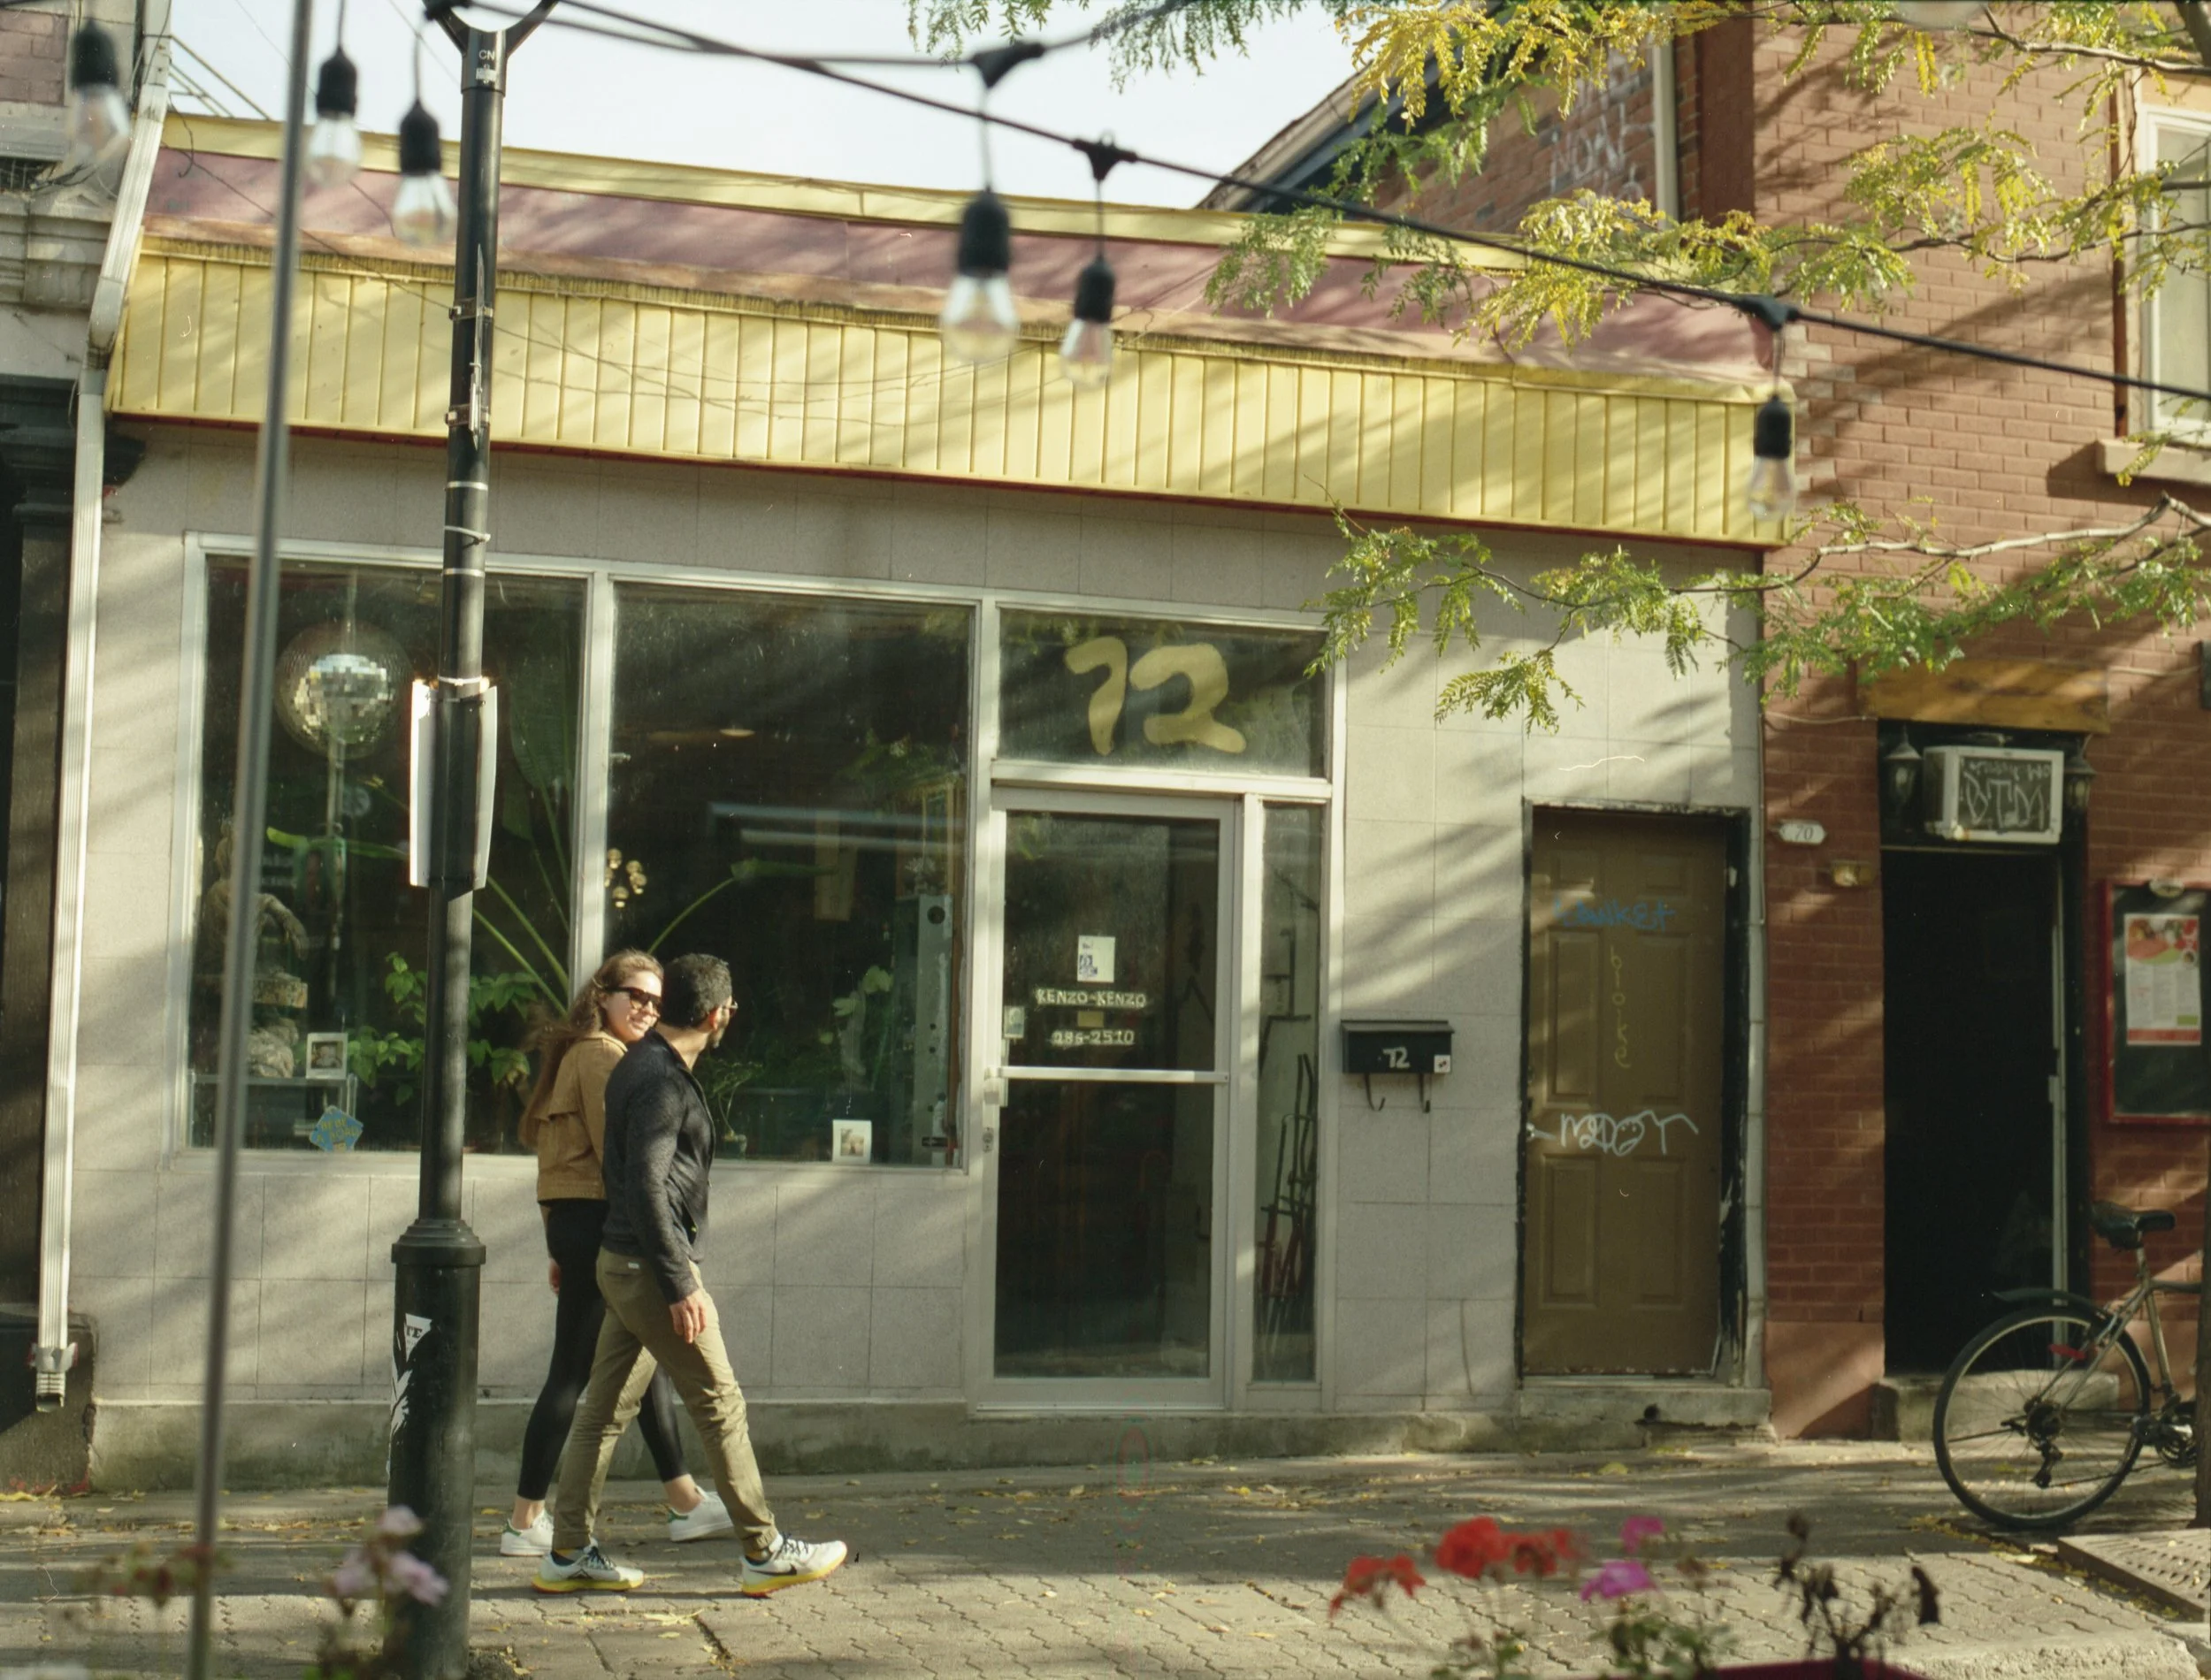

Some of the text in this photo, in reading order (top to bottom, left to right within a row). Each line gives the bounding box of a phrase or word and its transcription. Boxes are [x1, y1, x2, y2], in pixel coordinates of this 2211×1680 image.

[1066, 637, 1246, 756] 72
[1794, 823, 1815, 840] 70
[1036, 988, 1147, 1008] KENZO-KENZO
[1382, 1046, 1411, 1068] 72
